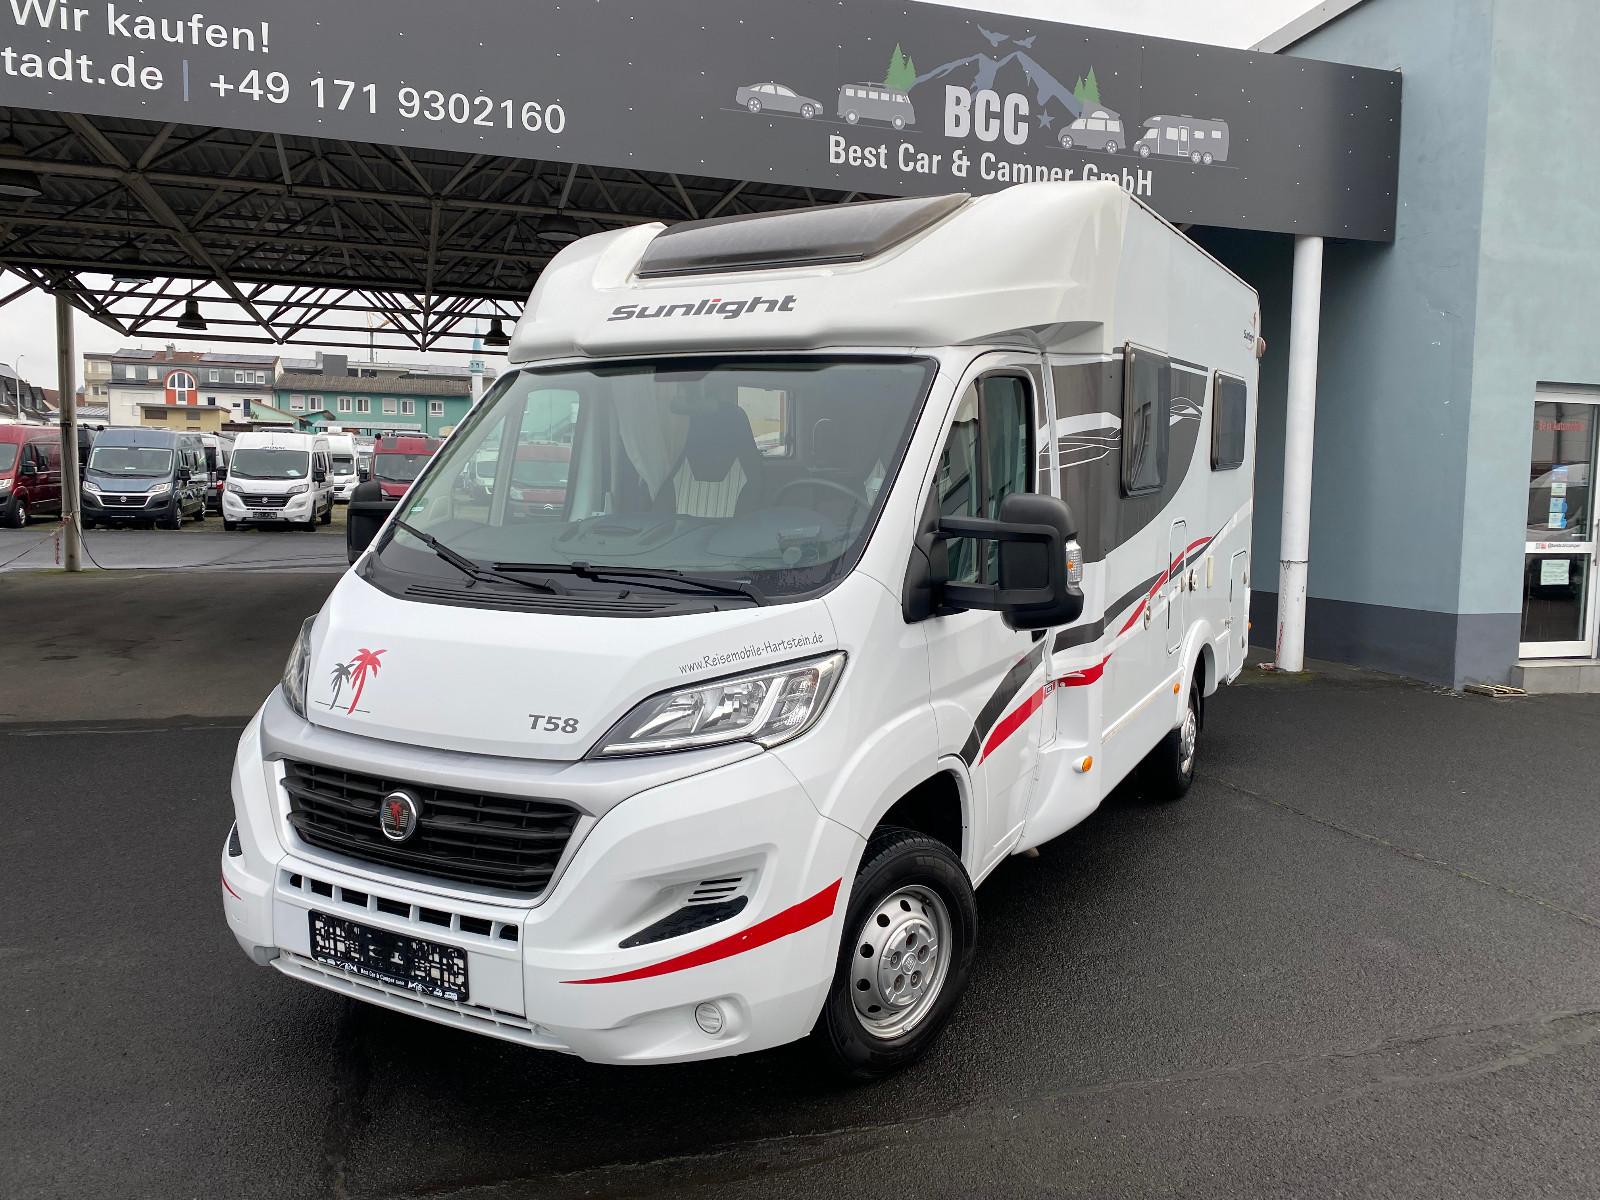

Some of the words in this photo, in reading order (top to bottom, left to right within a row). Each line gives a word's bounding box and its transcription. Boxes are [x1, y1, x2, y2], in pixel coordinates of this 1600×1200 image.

[9, 0, 89, 31] Wir
[106, 3, 269, 53] kaufen!
[0, 46, 164, 90] tadt.de
[209, 69, 290, 104] +49
[310, 77, 376, 114] 171
[398, 87, 566, 134] 9302160
[944, 84, 1030, 146] BCC
[829, 134, 888, 169] Best
[898, 142, 942, 174] Car
[951, 149, 971, 178] &
[980, 152, 1074, 183] Camper
[678, 631, 824, 675] www.Reisemobile-Hartstein.de
[528, 713, 579, 734] T58
